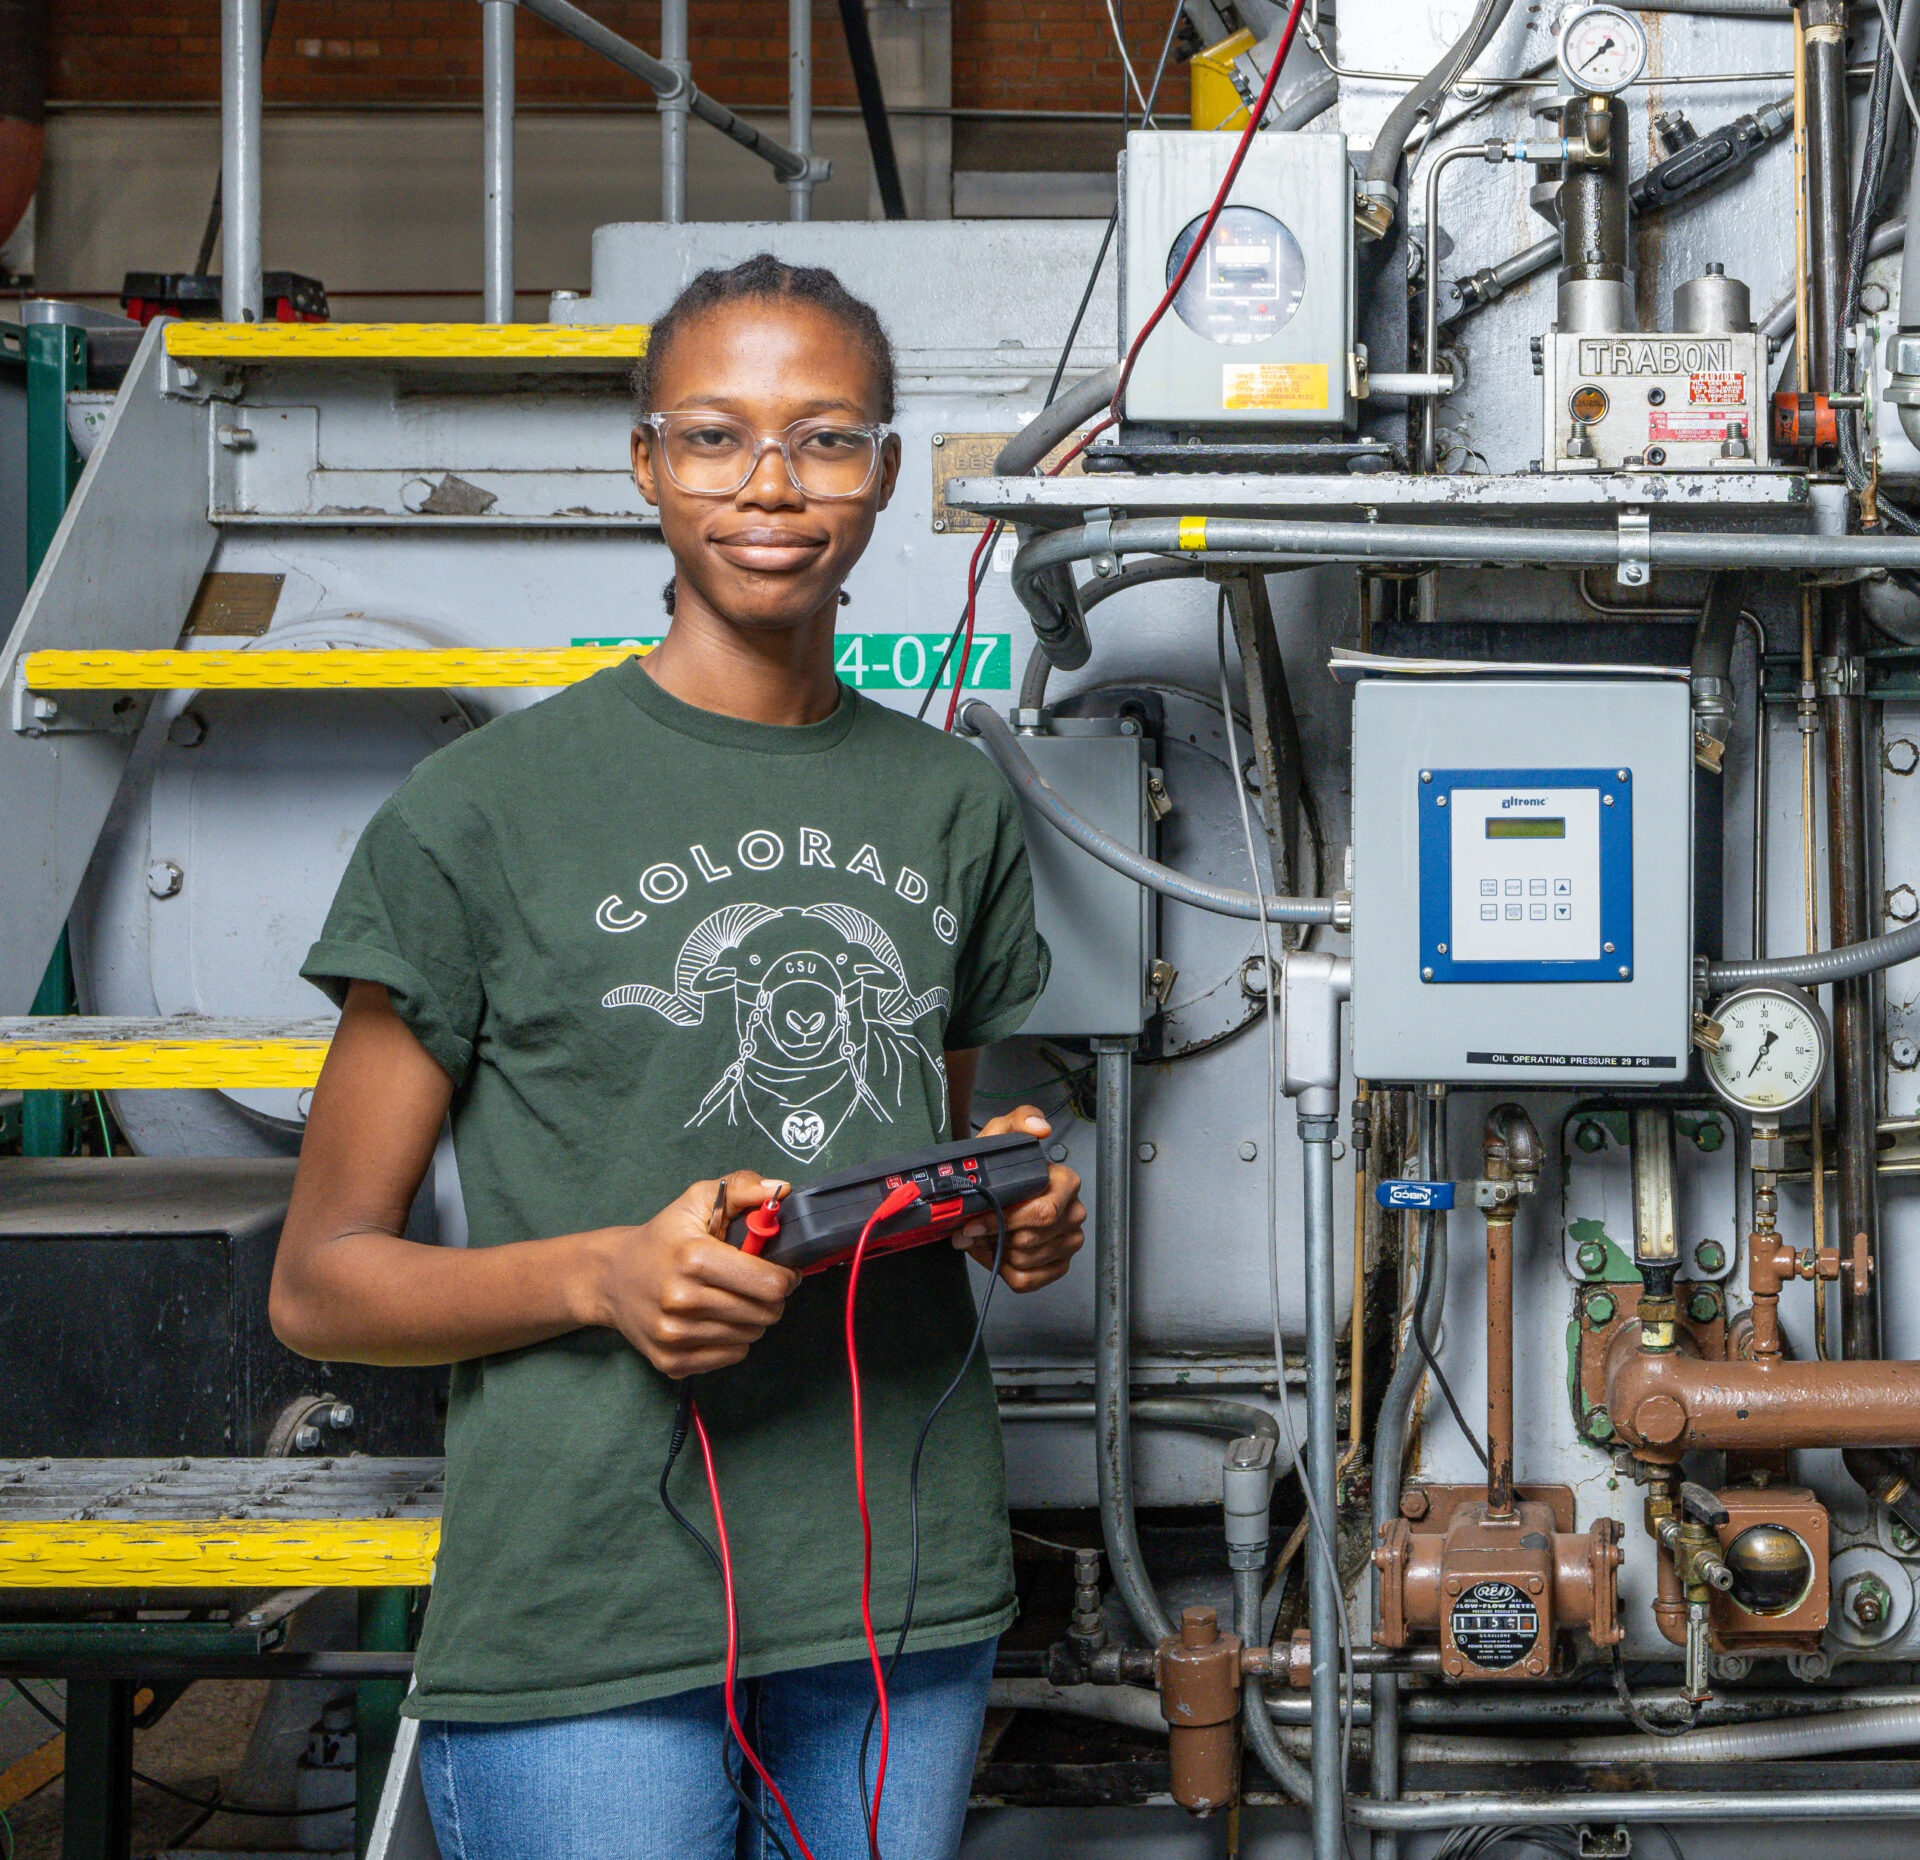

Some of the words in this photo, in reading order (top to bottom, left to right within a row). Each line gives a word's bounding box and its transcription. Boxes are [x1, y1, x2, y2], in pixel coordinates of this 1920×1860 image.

[1587, 343, 1725, 374] TRABON
[596, 826, 958, 945] COLORADO
[785, 960, 816, 974] CSU
[1760, 1010, 1769, 1019] 30
[1735, 1020, 1744, 1029] 20
[1784, 1021, 1794, 1030] 40
[1725, 1044, 1732, 1053] 10
[1795, 1046, 1804, 1055] 50
[1492, 1054, 1509, 1063] OIL
[1512, 1055, 1566, 1065] OPERATING
[1570, 1056, 1617, 1066] PRESSURE
[1621, 1057, 1632, 1066] 29
[1635, 1057, 1650, 1066] PSI
[1735, 1070, 1741, 1079] 0
[1784, 1071, 1794, 1080] 60
[1393, 1190, 1428, 1200] NIBCO
